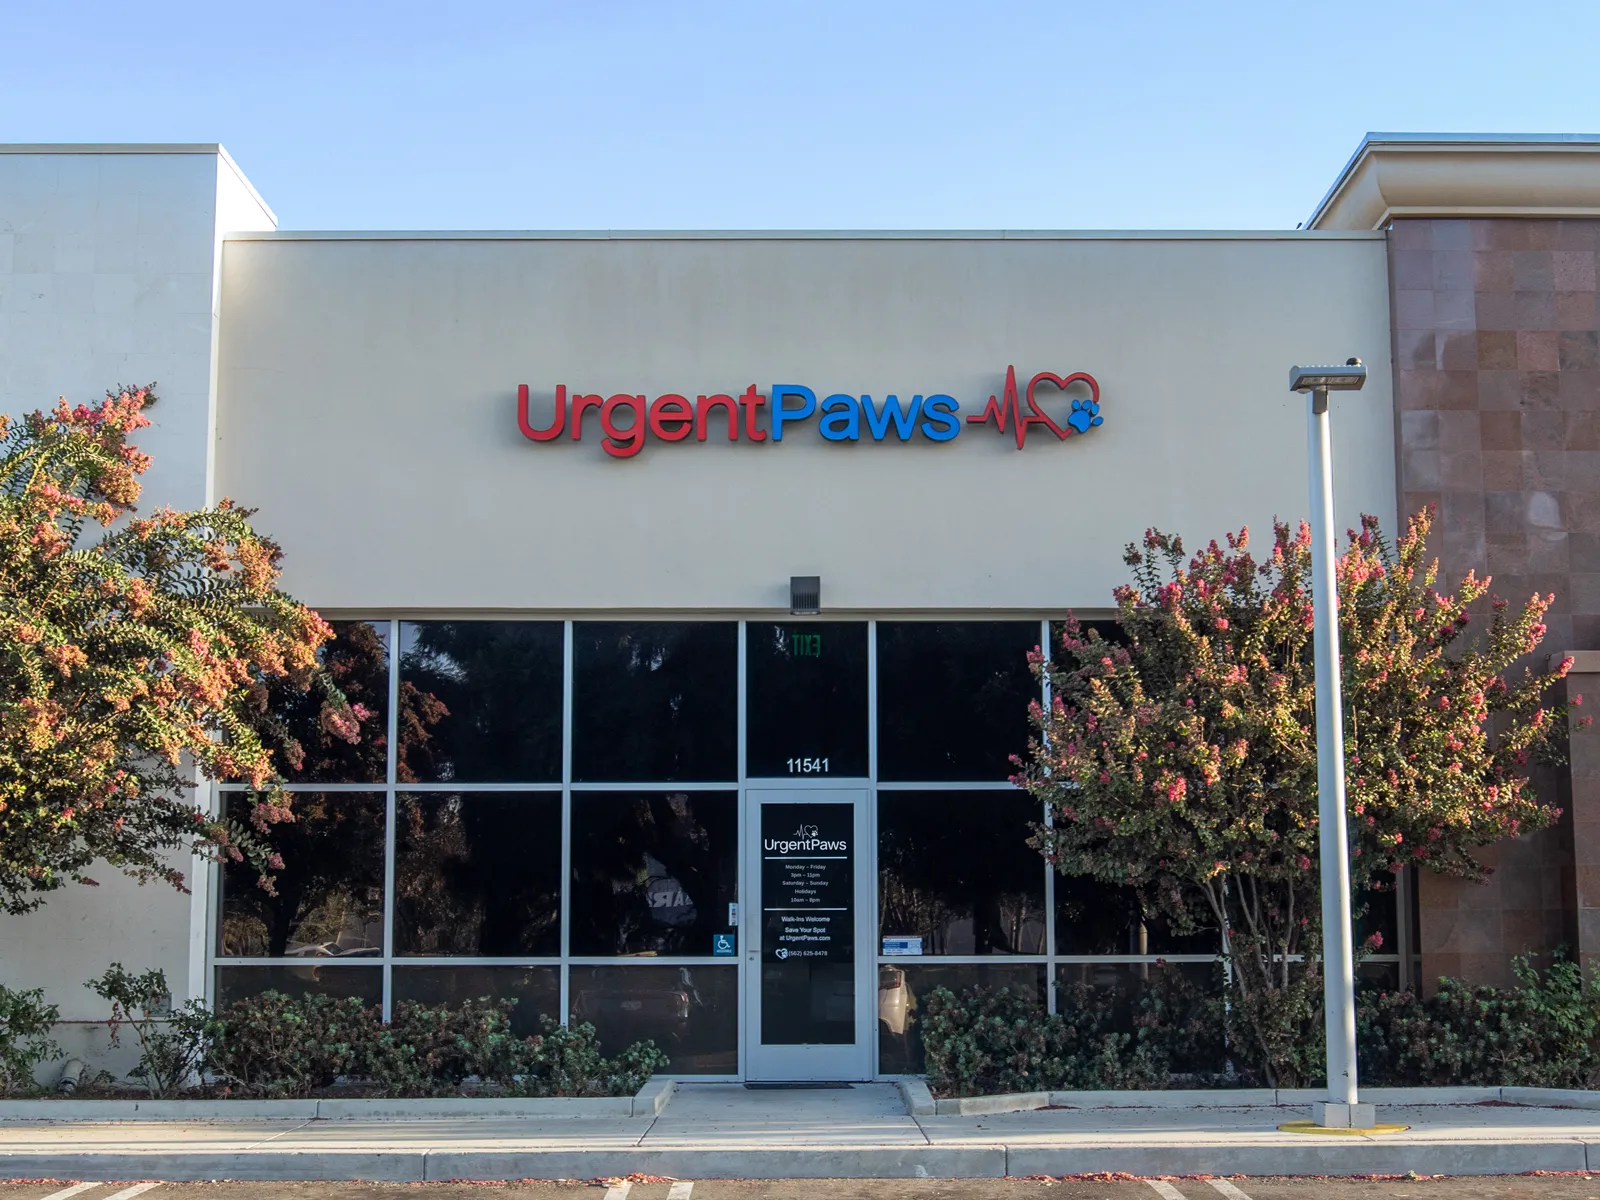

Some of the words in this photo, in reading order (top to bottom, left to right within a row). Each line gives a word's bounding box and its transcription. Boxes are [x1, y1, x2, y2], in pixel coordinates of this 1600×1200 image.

[516, 384, 960, 458] UrgentPaws
[787, 758, 829, 773] 11541
[764, 839, 847, 854] UrgentPaws
